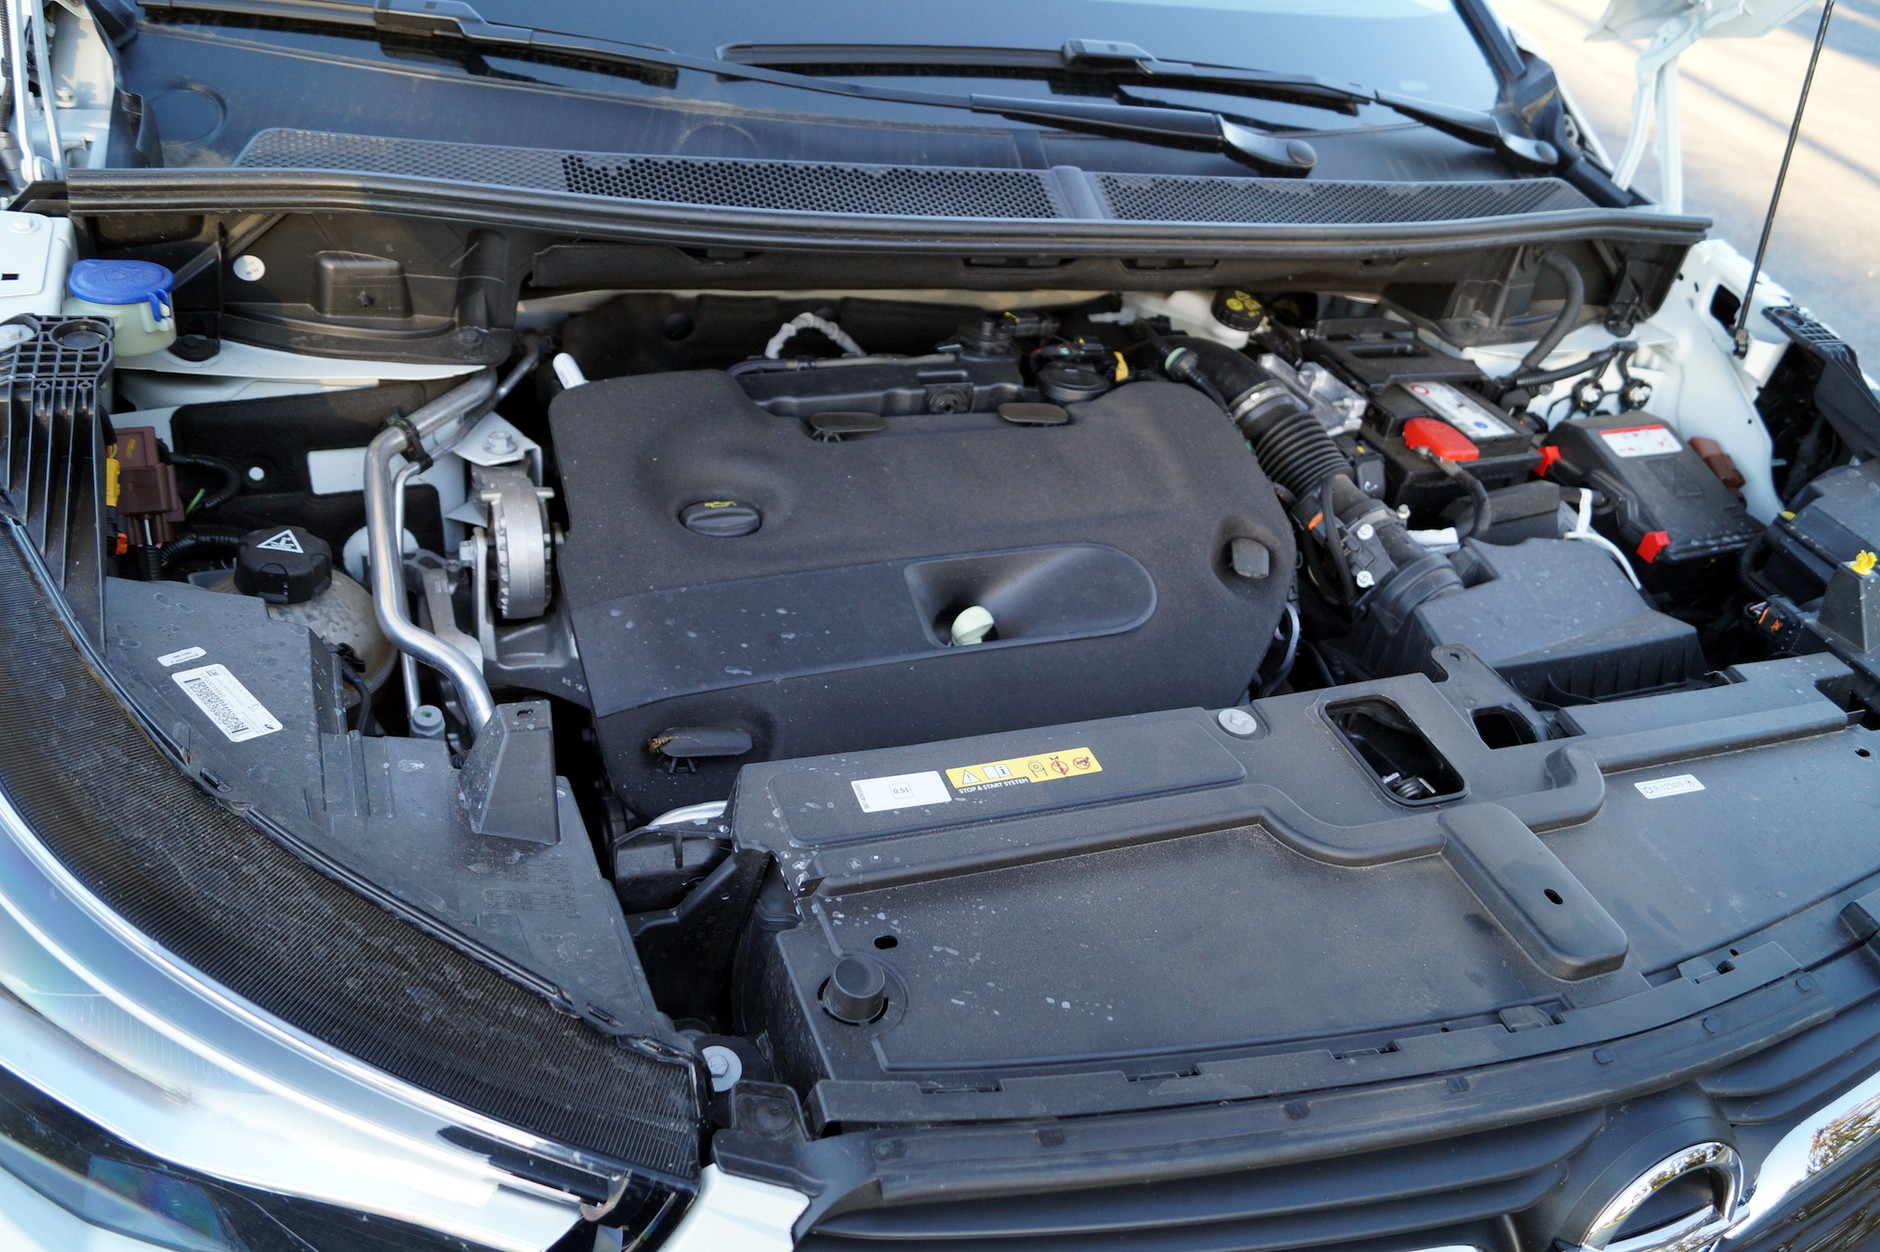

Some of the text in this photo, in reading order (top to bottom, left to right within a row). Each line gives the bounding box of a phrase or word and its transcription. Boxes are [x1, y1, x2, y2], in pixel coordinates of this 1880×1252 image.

[959, 786, 977, 794] STOP
[983, 780, 1003, 790] START
[1003, 777, 1029, 786] SYSTEM
